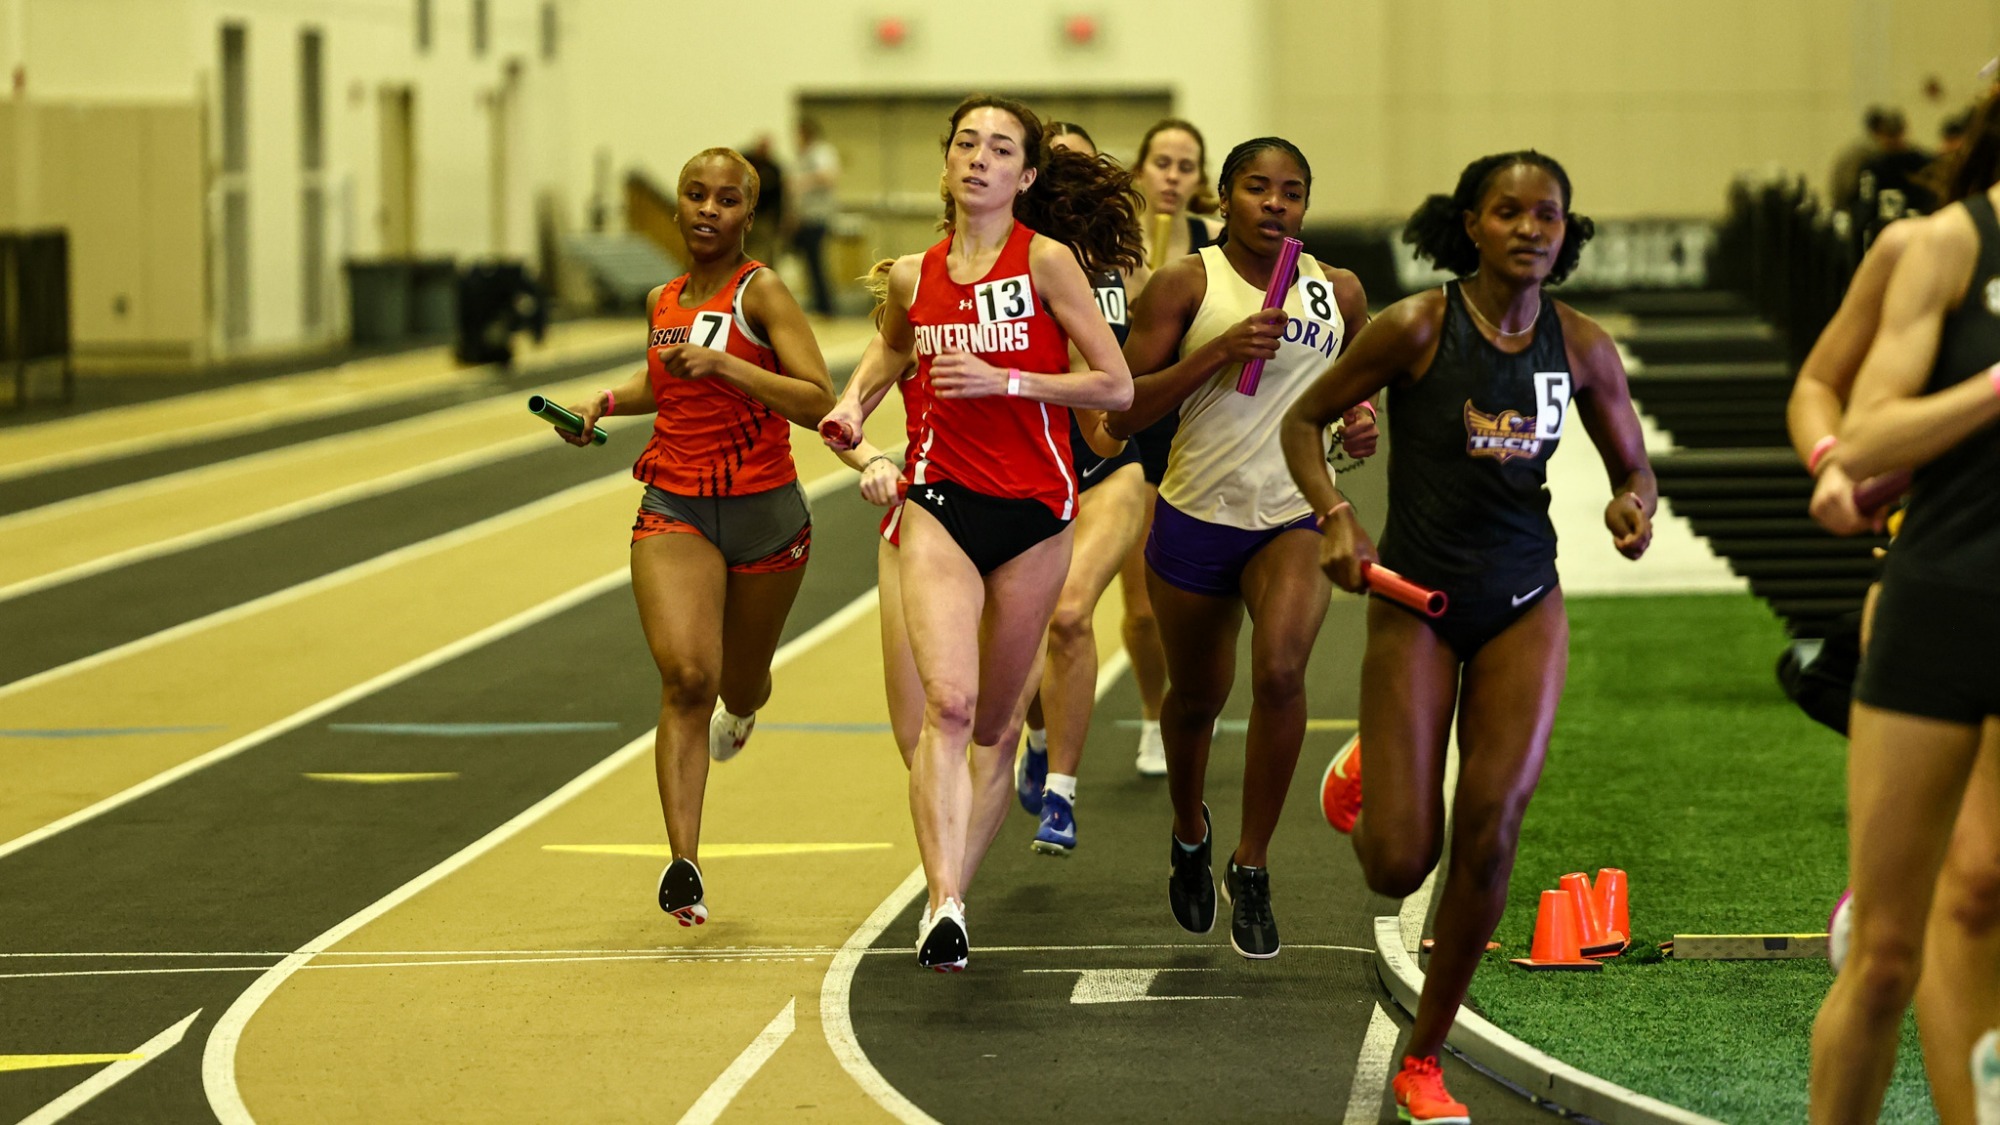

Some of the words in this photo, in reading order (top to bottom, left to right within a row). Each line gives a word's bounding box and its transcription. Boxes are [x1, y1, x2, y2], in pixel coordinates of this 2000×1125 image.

[979, 279, 1026, 321] 13
[1306, 280, 1332, 321] 8
[702, 314, 723, 349] 7
[914, 321, 1029, 356] GOVERNORS
[1282, 317, 1339, 359] ORN
[1546, 377, 1563, 434] 5
[1470, 436, 1540, 454] TECH
